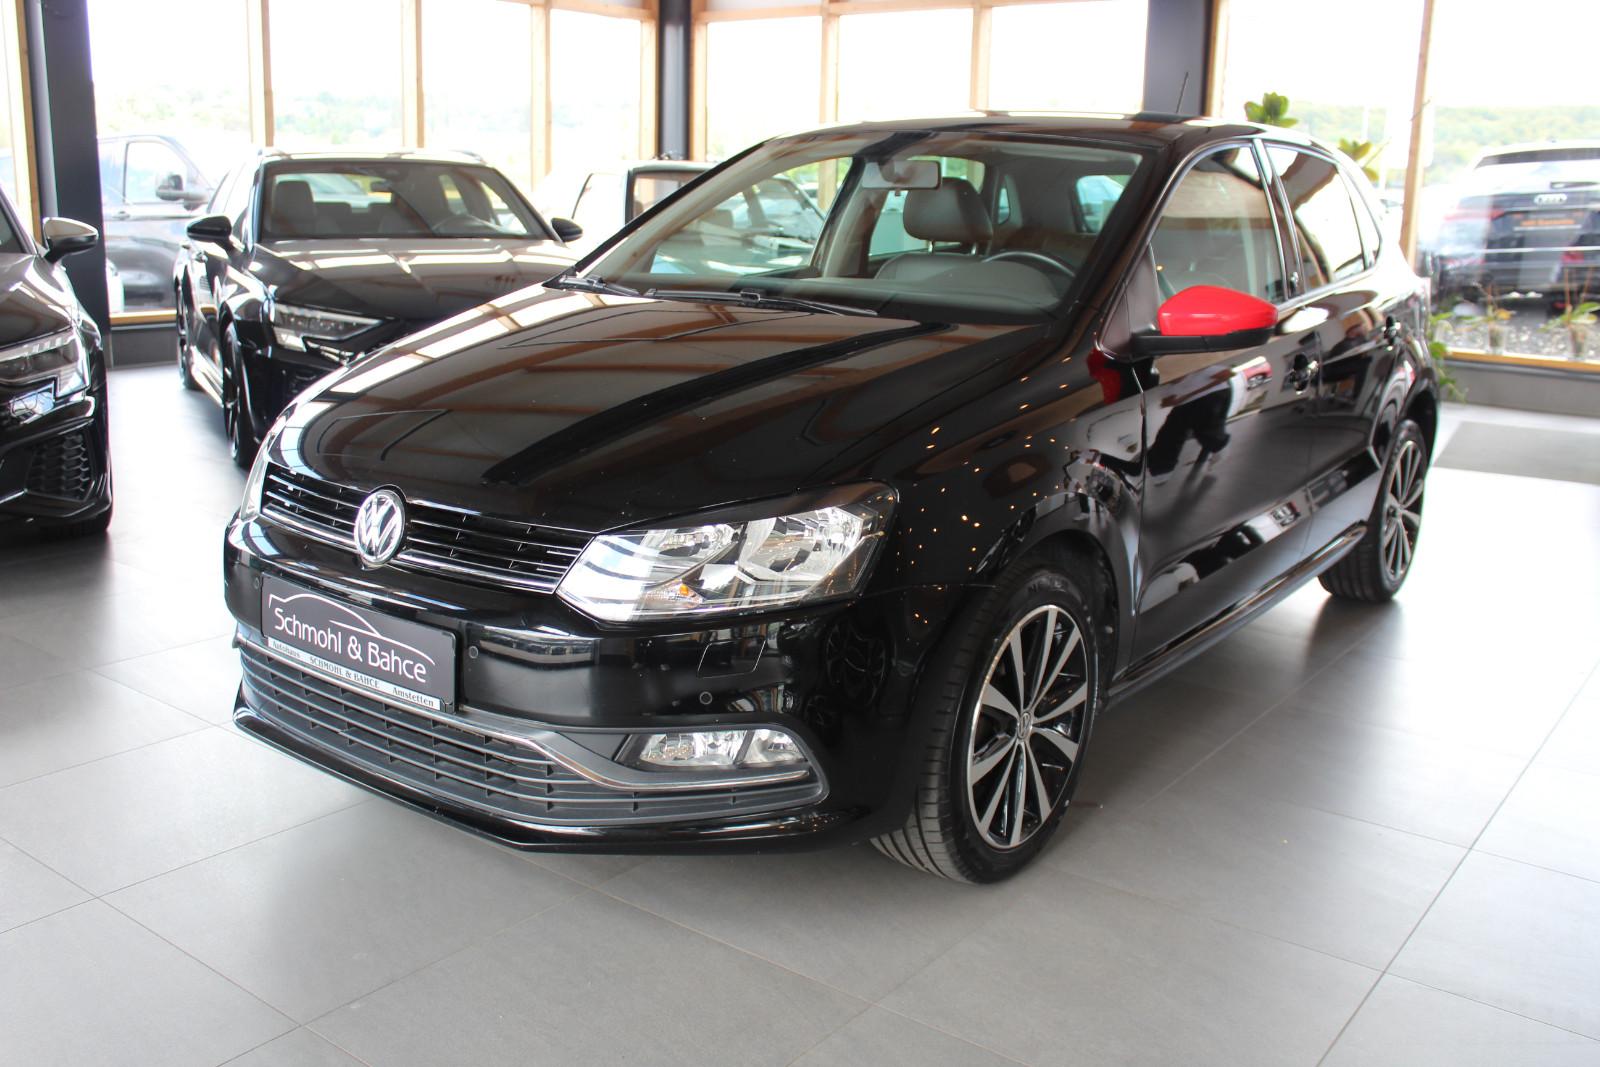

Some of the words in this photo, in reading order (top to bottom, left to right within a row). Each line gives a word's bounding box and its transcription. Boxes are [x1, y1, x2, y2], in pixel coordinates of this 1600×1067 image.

[271, 640, 301, 659] Autohaus
[309, 656, 343, 675] SCHMOHL
[345, 670, 352, 678] &
[354, 673, 380, 688] BAHCE
[392, 687, 434, 707] Amstetten
[274, 607, 342, 655] Schmohl
[347, 635, 363, 662] &
[367, 641, 427, 683] Bahce
